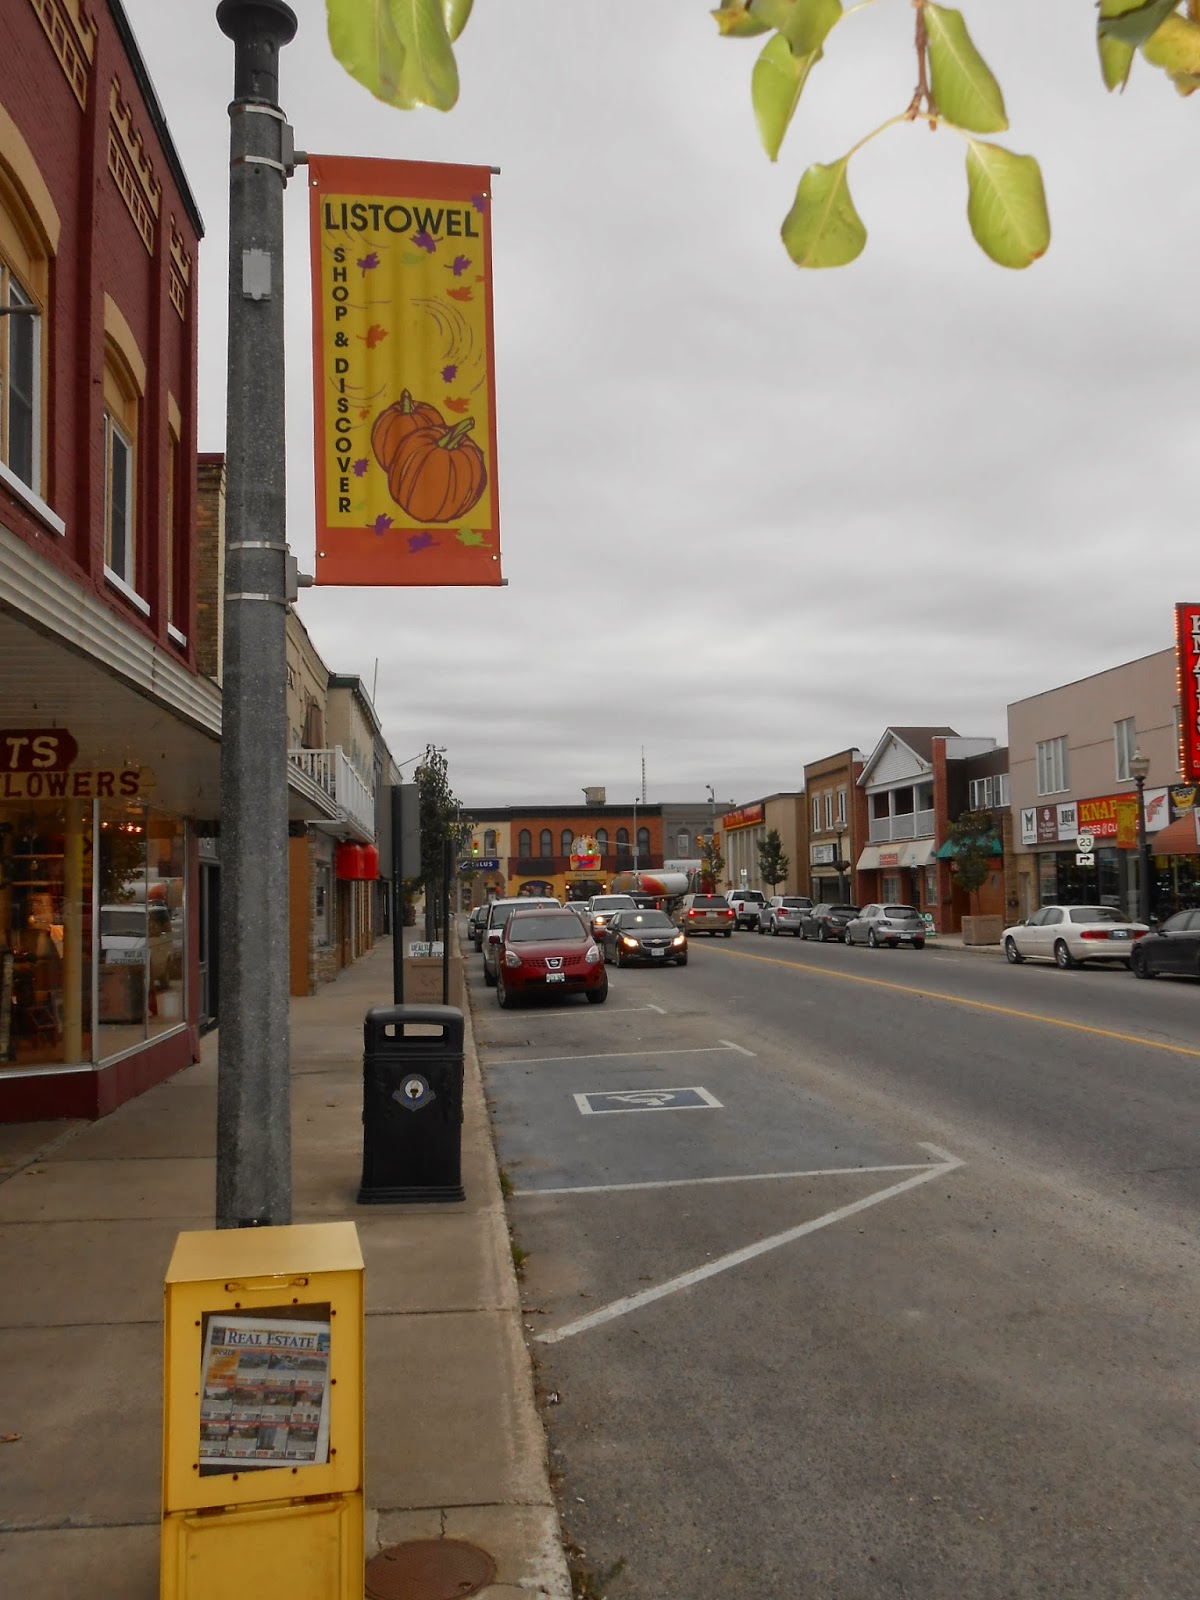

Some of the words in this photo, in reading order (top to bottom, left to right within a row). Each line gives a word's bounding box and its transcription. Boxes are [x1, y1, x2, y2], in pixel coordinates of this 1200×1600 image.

[325, 203, 479, 237] LISTOWEL
[332, 247, 349, 321] SHOP
[334, 331, 349, 347] &
[334, 357, 352, 513] DISCOVER
[0, 771, 140, 797] LOWERS
[1080, 838, 1091, 847] 23
[228, 1331, 262, 1345] REAL
[267, 1333, 315, 1348] ESTATE
